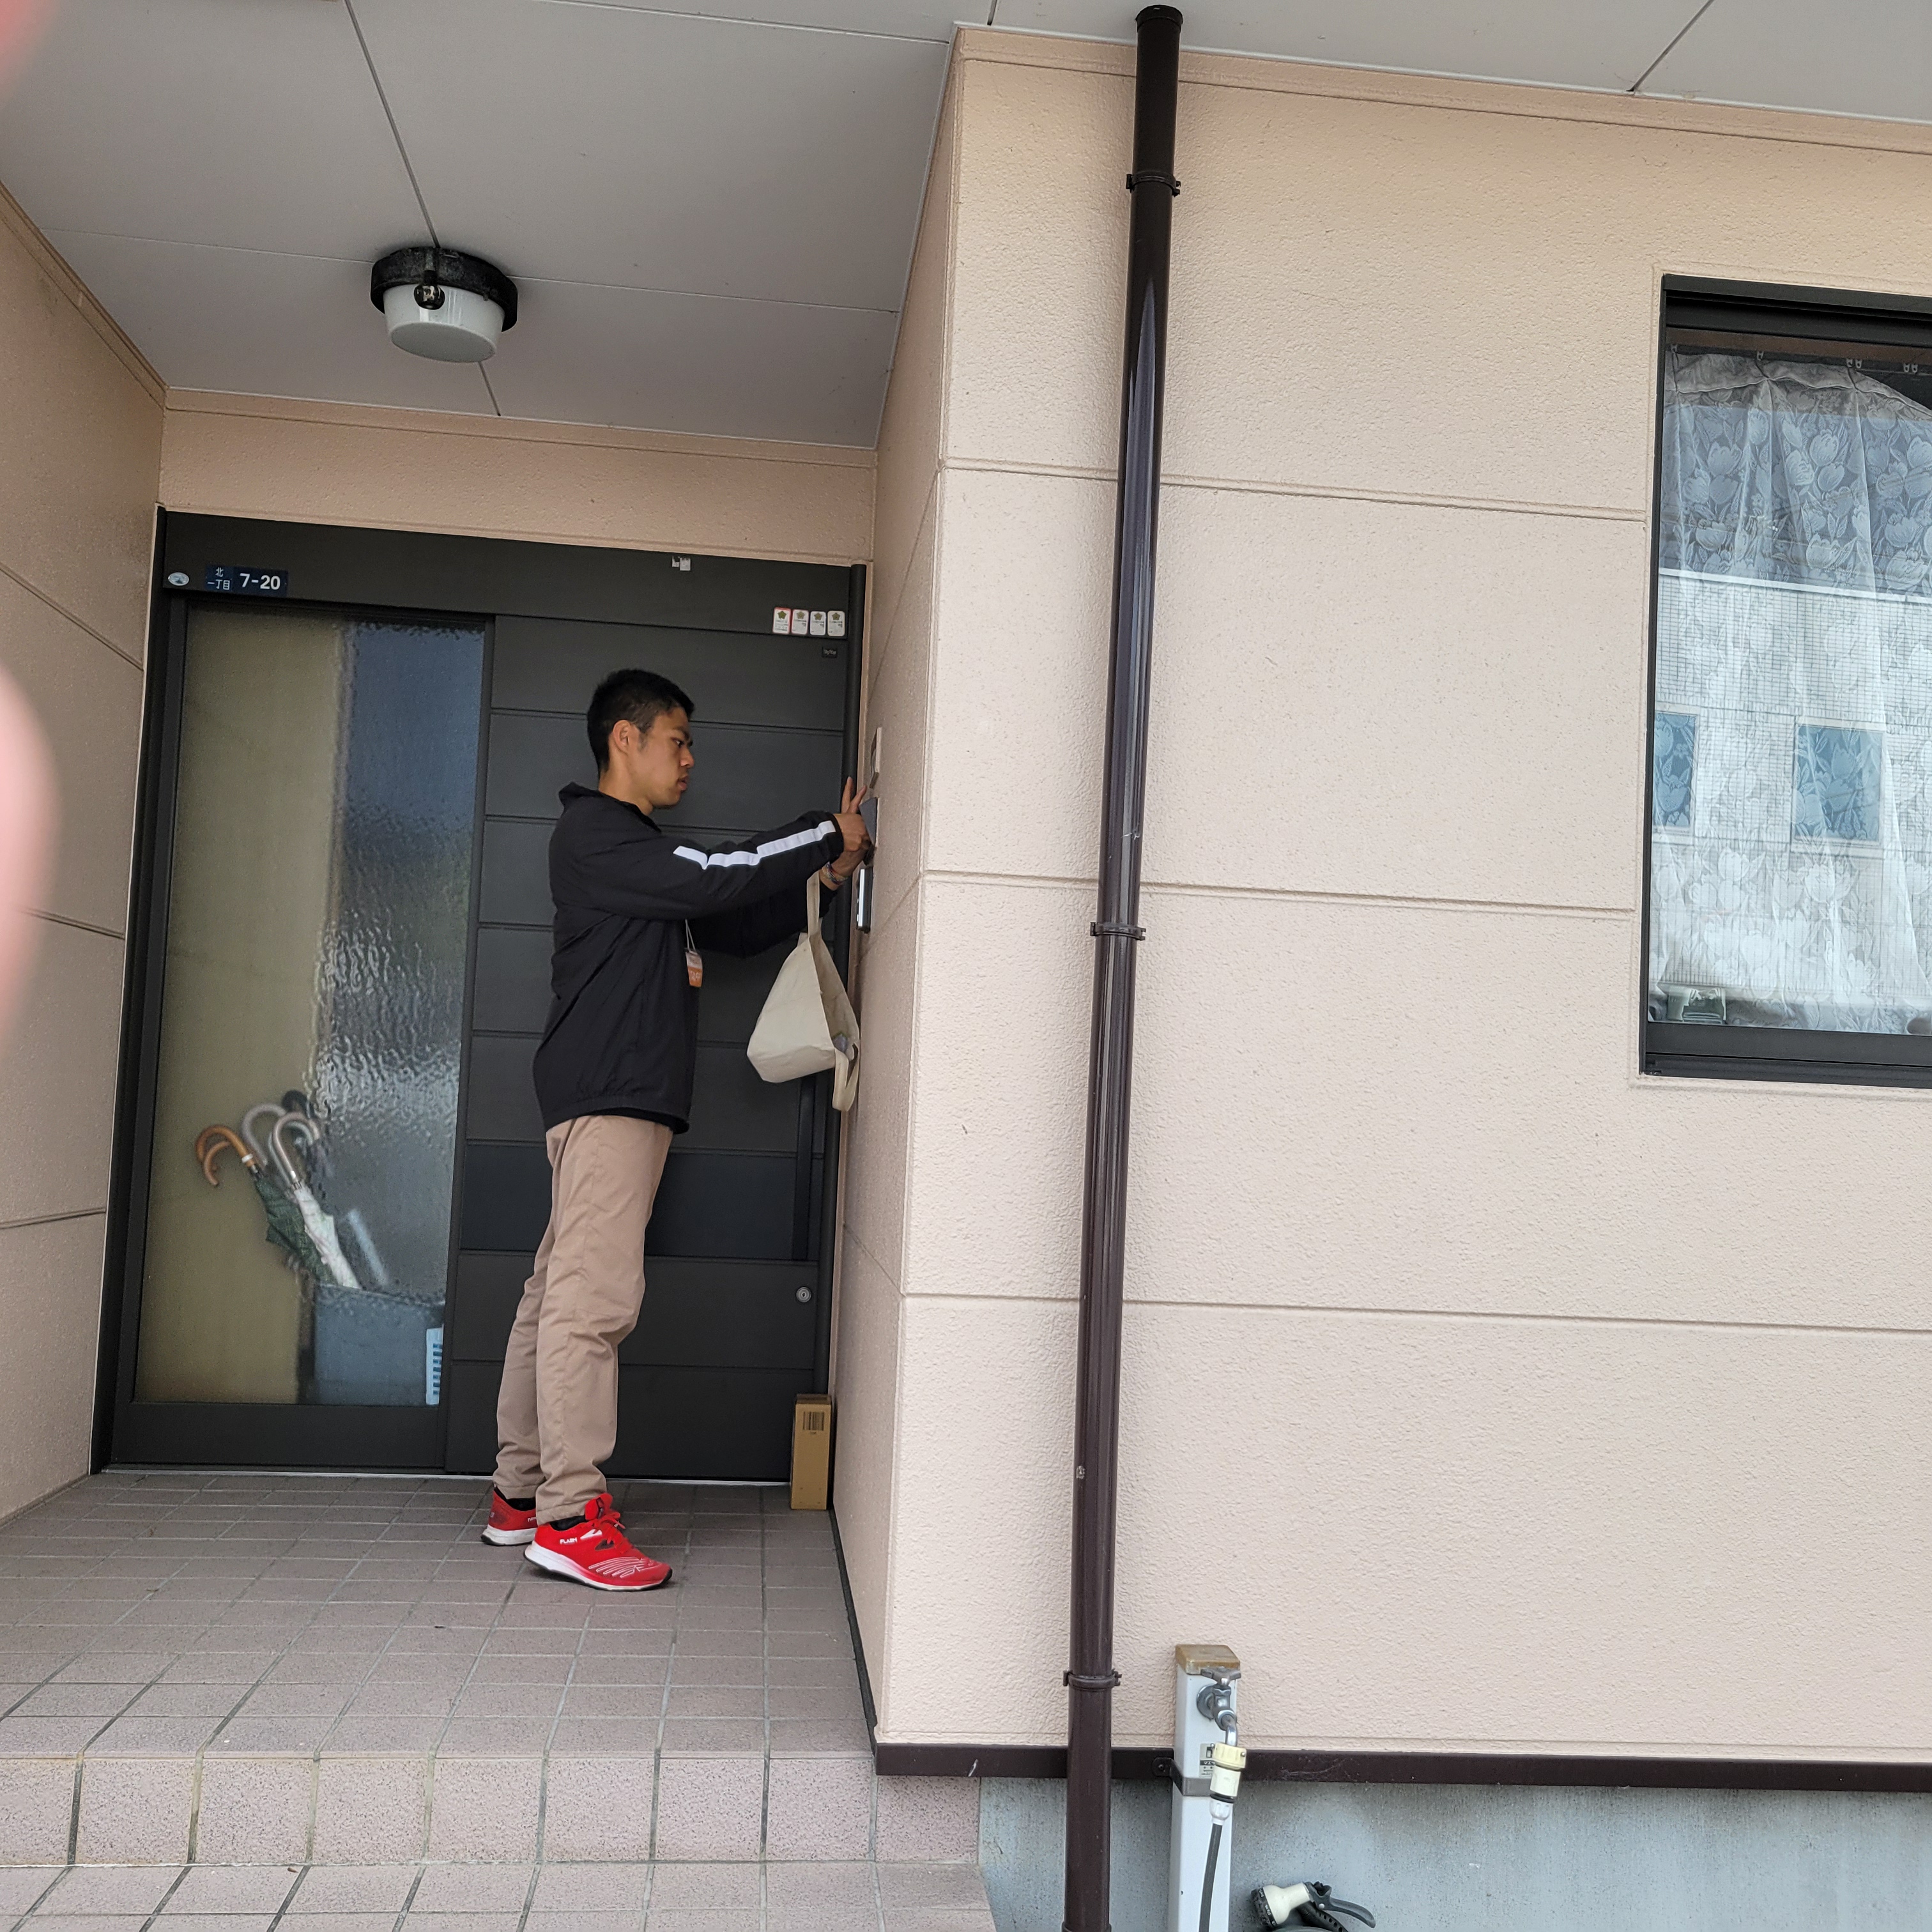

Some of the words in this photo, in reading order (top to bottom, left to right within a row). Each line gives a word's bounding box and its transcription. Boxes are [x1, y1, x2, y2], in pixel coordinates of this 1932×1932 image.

[215, 567, 224, 578] 北
[207, 579, 230, 590] 一丁目
[240, 572, 280, 590] 7-20
